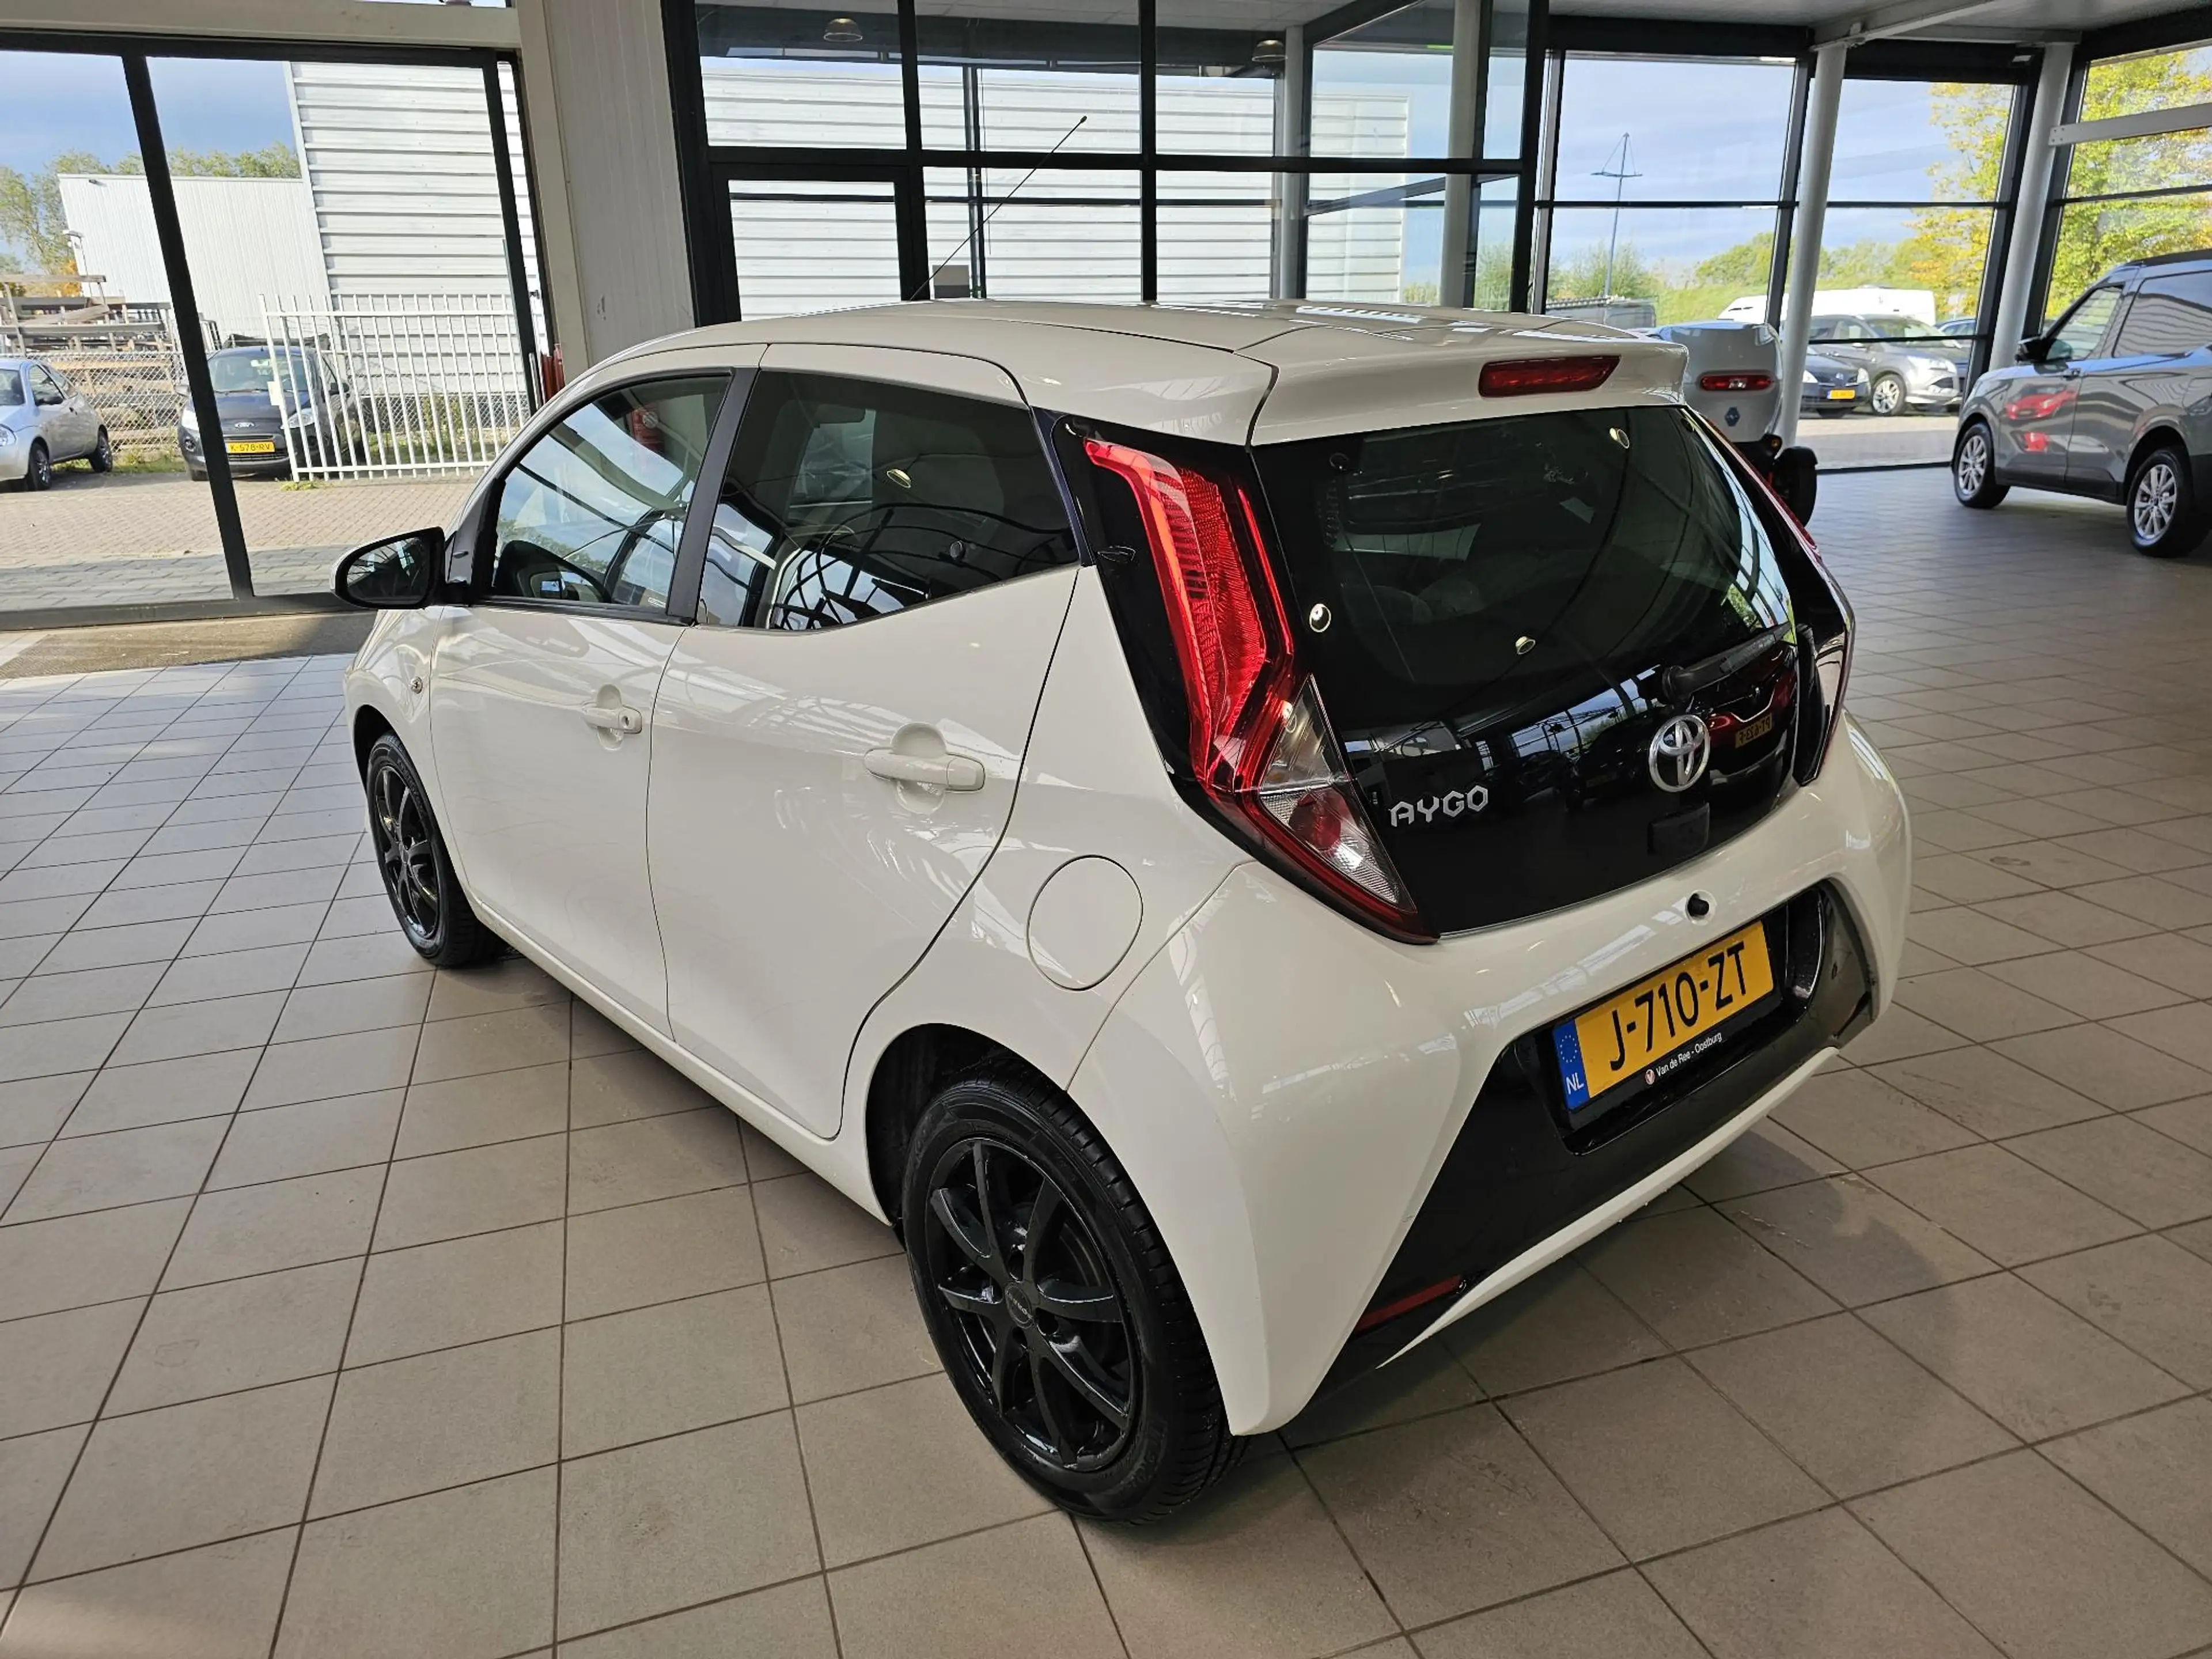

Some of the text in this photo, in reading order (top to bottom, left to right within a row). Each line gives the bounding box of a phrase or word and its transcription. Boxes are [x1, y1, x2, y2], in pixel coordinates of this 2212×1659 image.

[1389, 785, 1488, 827] AYGO
[1609, 941, 1746, 1071] J-710-ZT
[1656, 1065, 1669, 1077] Van
[1670, 1058, 1678, 1069] de
[1677, 1051, 1691, 1064] Ree
[1695, 1032, 1722, 1053] Oostburg
[1565, 1072, 1584, 1094] NL
